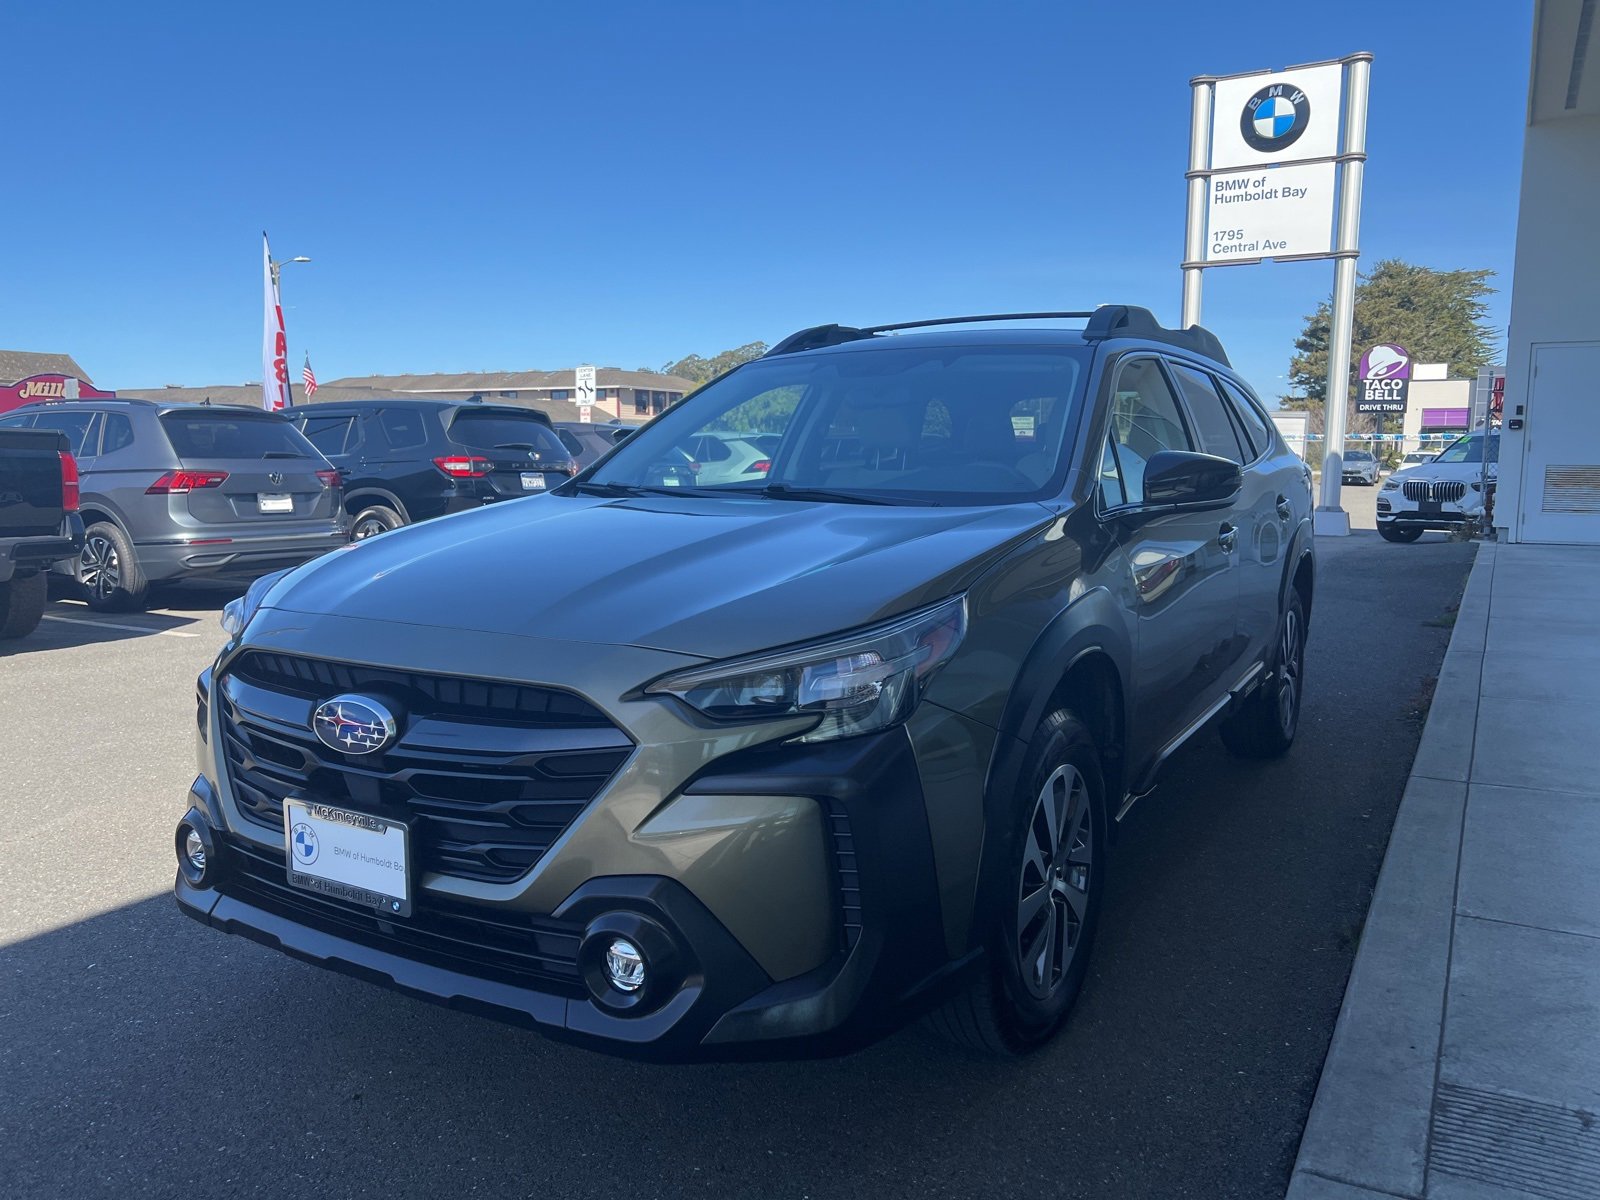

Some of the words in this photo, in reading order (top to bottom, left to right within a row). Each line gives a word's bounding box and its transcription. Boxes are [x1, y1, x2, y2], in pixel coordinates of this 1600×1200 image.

[1248, 85, 1304, 110] BMW
[1215, 178, 1250, 192] BMW
[1252, 176, 1267, 188] of
[1214, 188, 1279, 204] Humboldt
[1282, 186, 1308, 199] Bay
[1213, 229, 1244, 241] 1795
[1212, 240, 1259, 254] Central
[1262, 239, 1287, 251] Ave
[19, 381, 80, 398] Mill
[1363, 379, 1403, 390] TACO
[1364, 389, 1402, 401] BELL
[1359, 403, 1381, 411] DRIVE
[1382, 403, 1403, 411] THRU
[313, 804, 377, 829] McKinleyville
[294, 825, 315, 838] BMW
[334, 846, 351, 859] BMW
[352, 851, 360, 860] of
[360, 854, 392, 869] Humboldt
[393, 861, 405, 872] Ba
[291, 873, 312, 887] BMW
[315, 880, 322, 890] of
[324, 882, 363, 901] Humboldt
[365, 892, 384, 909] Bay
